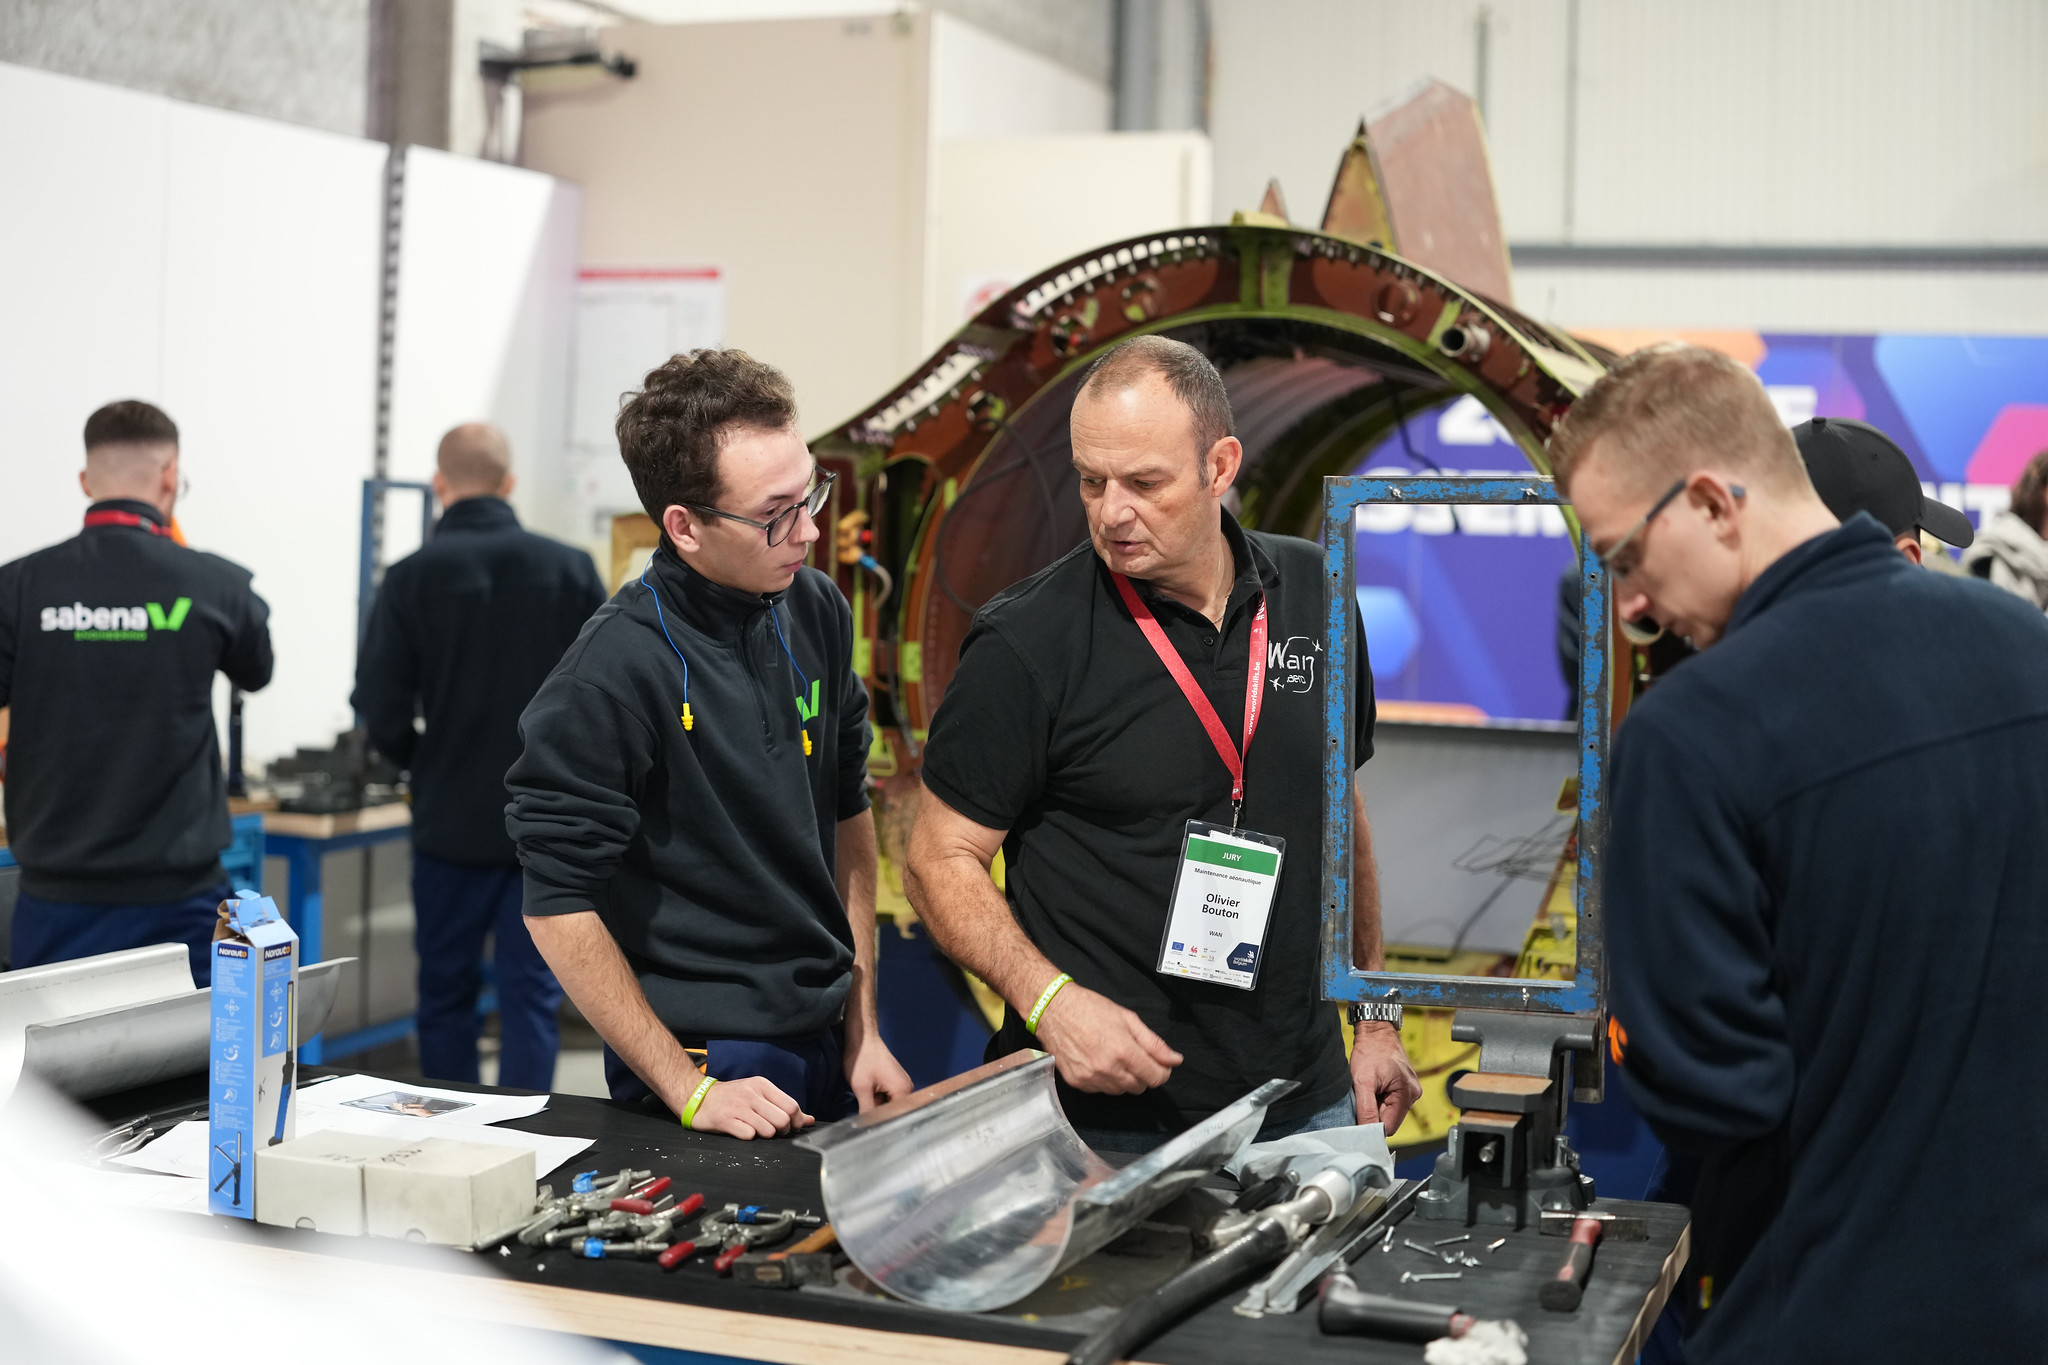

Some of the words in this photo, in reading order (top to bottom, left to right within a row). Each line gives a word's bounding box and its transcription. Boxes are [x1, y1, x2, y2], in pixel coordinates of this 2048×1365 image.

[40, 602, 149, 632] sabena
[1248, 661, 1261, 735] www.worldskills.be
[1222, 852, 1242, 862] JURY
[1194, 867, 1228, 879] Maintenance
[1206, 893, 1240, 907] Olivier
[1201, 904, 1239, 919] Bouton
[1209, 930, 1223, 938] WAN
[218, 947, 247, 958] Norauto
[264, 945, 291, 959] Norauto
